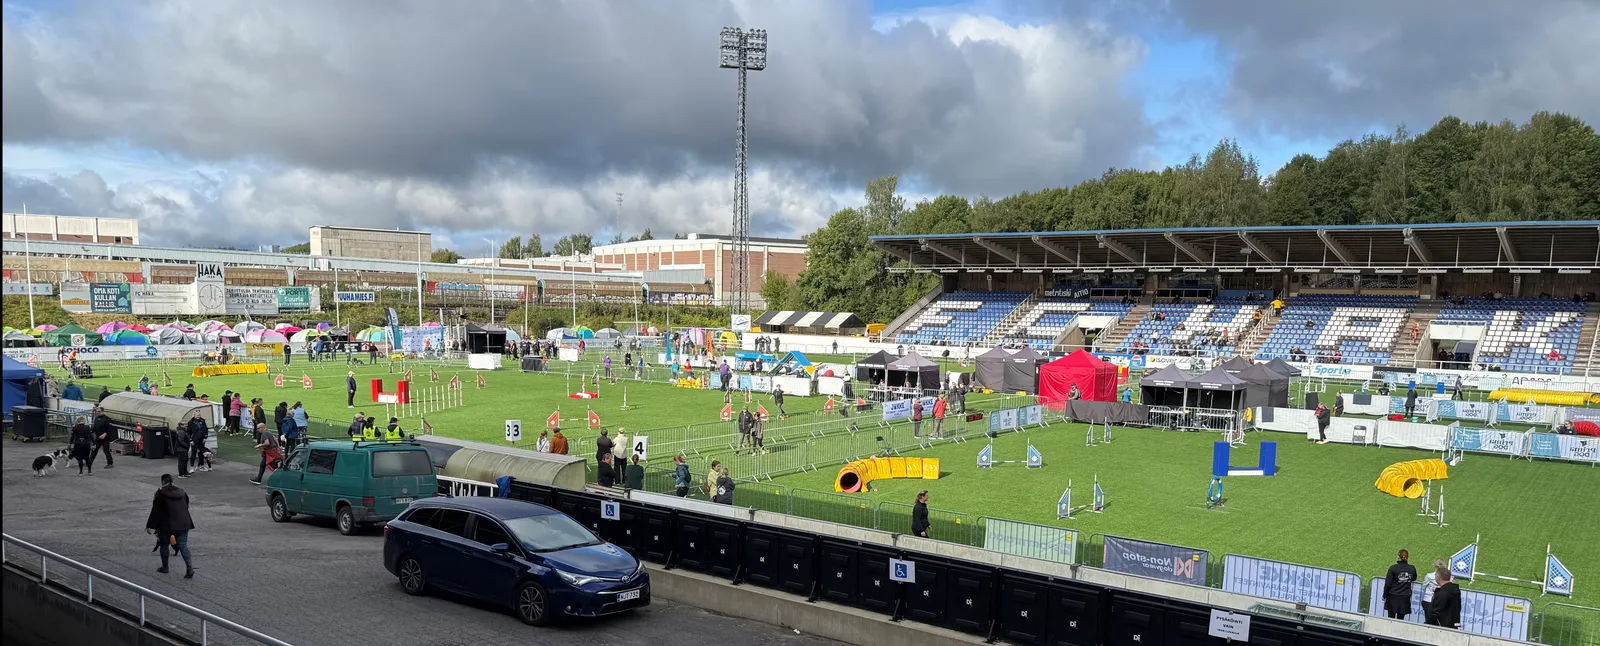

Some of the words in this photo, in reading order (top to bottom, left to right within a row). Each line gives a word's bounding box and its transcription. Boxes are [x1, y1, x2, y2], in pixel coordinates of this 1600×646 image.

[197, 264, 223, 278] HAKA
[1314, 365, 1352, 375] Sportia
[506, 425, 510, 436] 3
[513, 425, 520, 436] 3
[635, 442, 644, 454] 4
